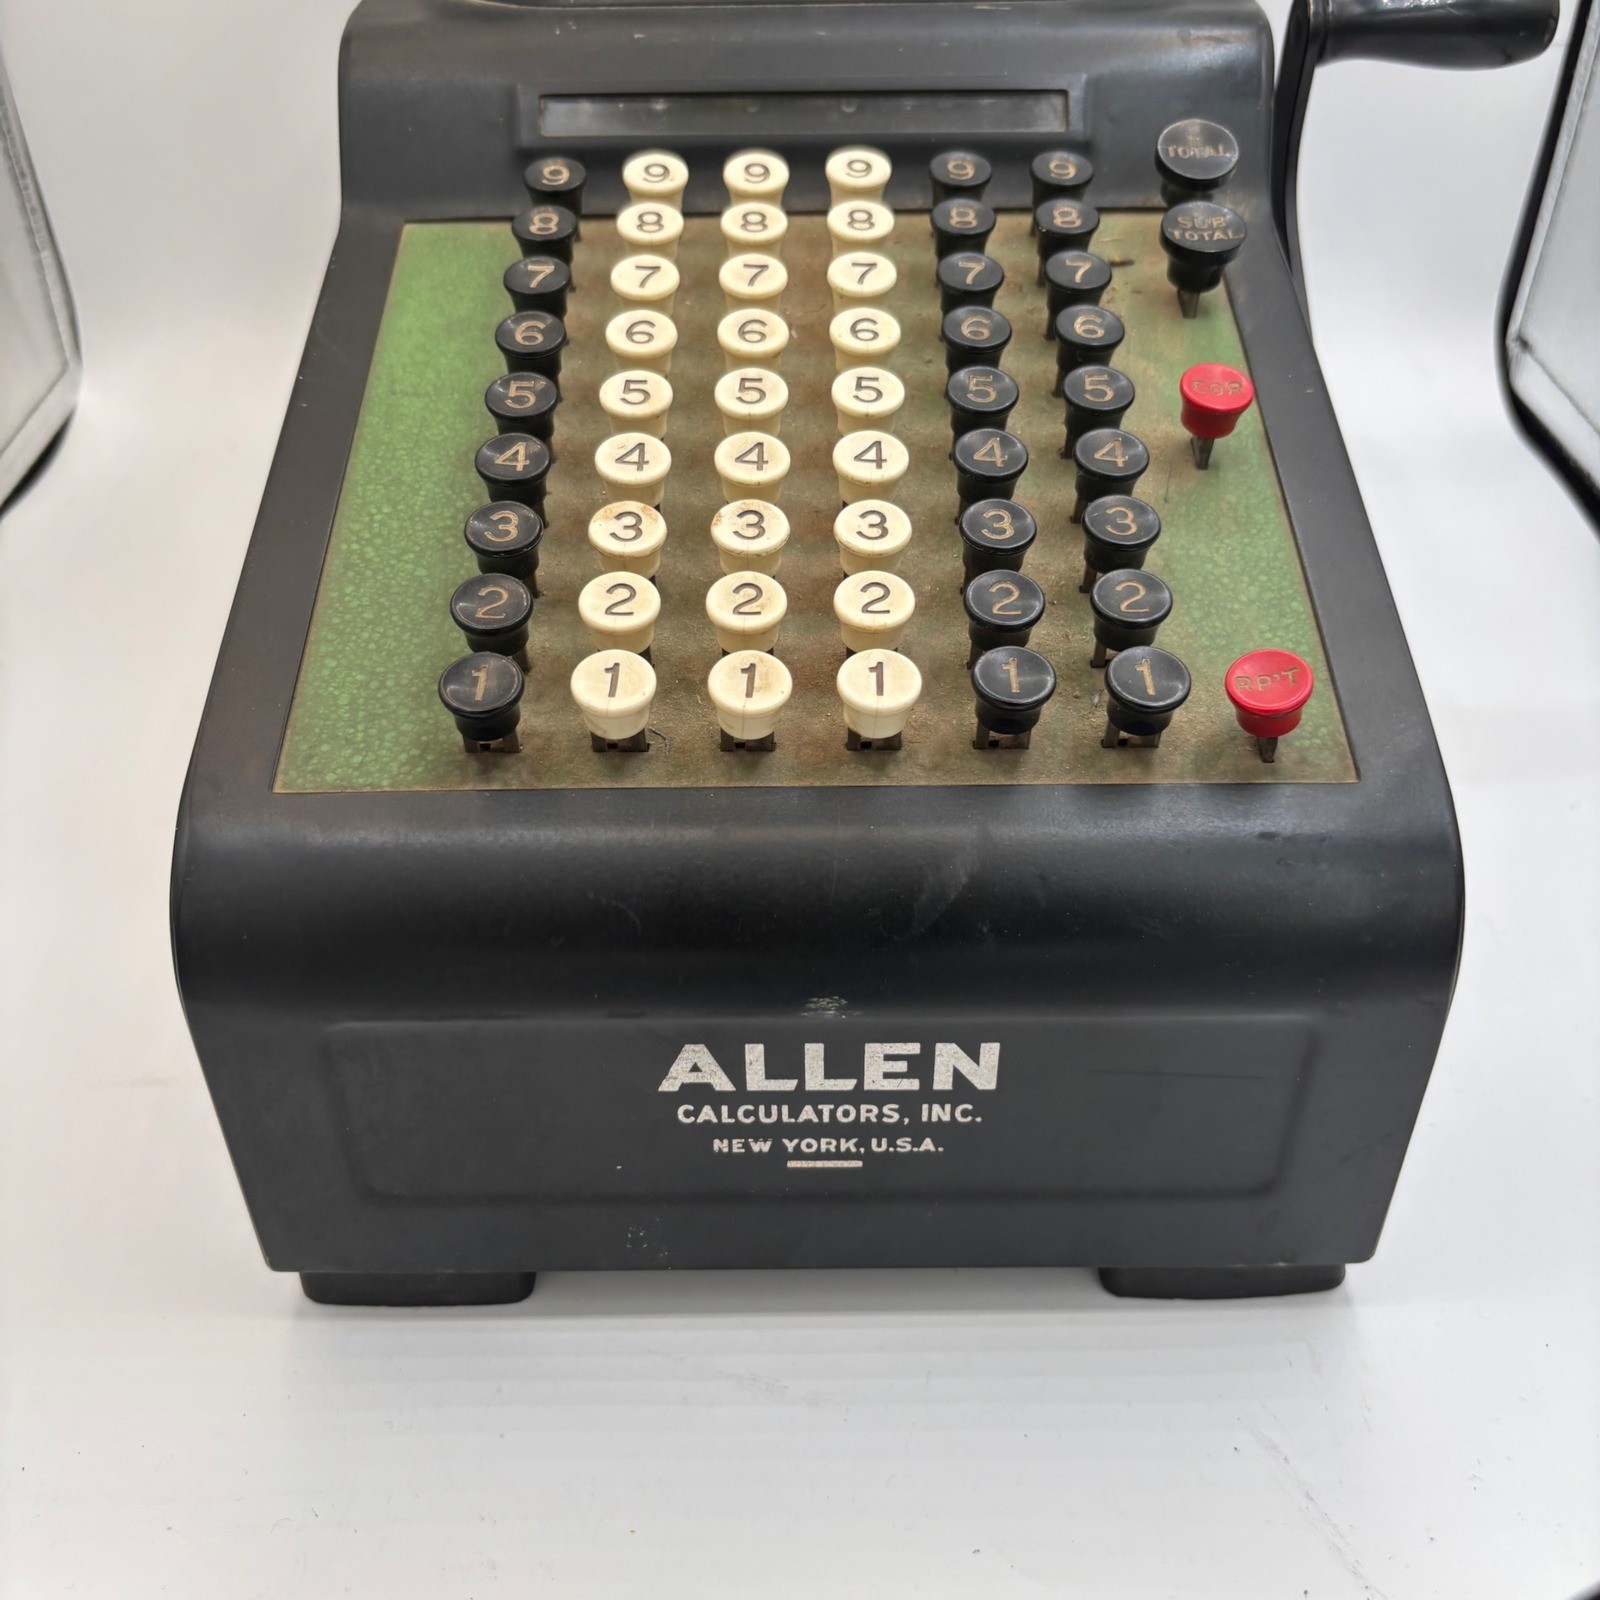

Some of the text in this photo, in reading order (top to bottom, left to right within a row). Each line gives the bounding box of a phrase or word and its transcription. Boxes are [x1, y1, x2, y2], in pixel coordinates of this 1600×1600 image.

[1164, 144, 1229, 160] TOTAL
[540, 165, 570, 186] 9
[644, 163, 670, 183] 9
[744, 163, 770, 183] 9
[846, 160, 872, 178] 9
[947, 160, 975, 180] 9
[1049, 160, 1076, 179] 9
[529, 212, 559, 235] 8
[636, 212, 664, 232] 8
[741, 212, 768, 232] 8
[847, 210, 874, 230] 8
[950, 208, 978, 229] 8
[1053, 208, 1081, 229] 8
[1177, 216, 1226, 229] SUB
[1173, 229, 1244, 242] TOTAL
[527, 265, 555, 288] 7
[635, 265, 661, 288] 7
[743, 264, 769, 286] 7
[851, 262, 877, 285] 7
[958, 261, 985, 284] 7
[1065, 259, 1092, 283] 7
[515, 322, 545, 346] 6
[626, 320, 656, 344] 6
[738, 319, 768, 343] 6
[850, 318, 879, 341] 6
[961, 315, 990, 340] 6
[1074, 315, 1104, 339] 6
[506, 381, 536, 408] 5
[620, 380, 651, 405] 5
[736, 378, 766, 403] 5
[853, 377, 883, 402] 5
[966, 376, 996, 403] 5
[1083, 374, 1113, 401] 5
[1192, 380, 1244, 394] COR
[495, 441, 530, 472] 4
[615, 442, 650, 471] 4
[735, 442, 769, 471] 4
[853, 441, 887, 470] 4
[973, 438, 1008, 468] 4
[1094, 438, 1129, 468] 4
[484, 510, 519, 542] 3
[609, 511, 643, 542] 3
[731, 510, 765, 540] 3
[856, 510, 889, 540] 3
[981, 509, 1015, 540] 3
[1105, 506, 1138, 536] 3
[475, 585, 509, 619] 2
[604, 582, 636, 616] 2
[732, 582, 763, 616] 2
[860, 582, 891, 614] 2
[989, 582, 1022, 616] 2
[1115, 581, 1149, 613] 2
[472, 664, 489, 701] 1
[604, 662, 621, 698] 1
[740, 662, 757, 699] 1
[868, 661, 884, 697] 1
[1001, 657, 1020, 693] 1
[1136, 658, 1155, 696] 1
[658, 1042, 1001, 1092] ALLEN
[677, 1103, 982, 1125] CALCULATORS, INC.
[713, 1138, 944, 1154] NEW YORK, U.S.A.
